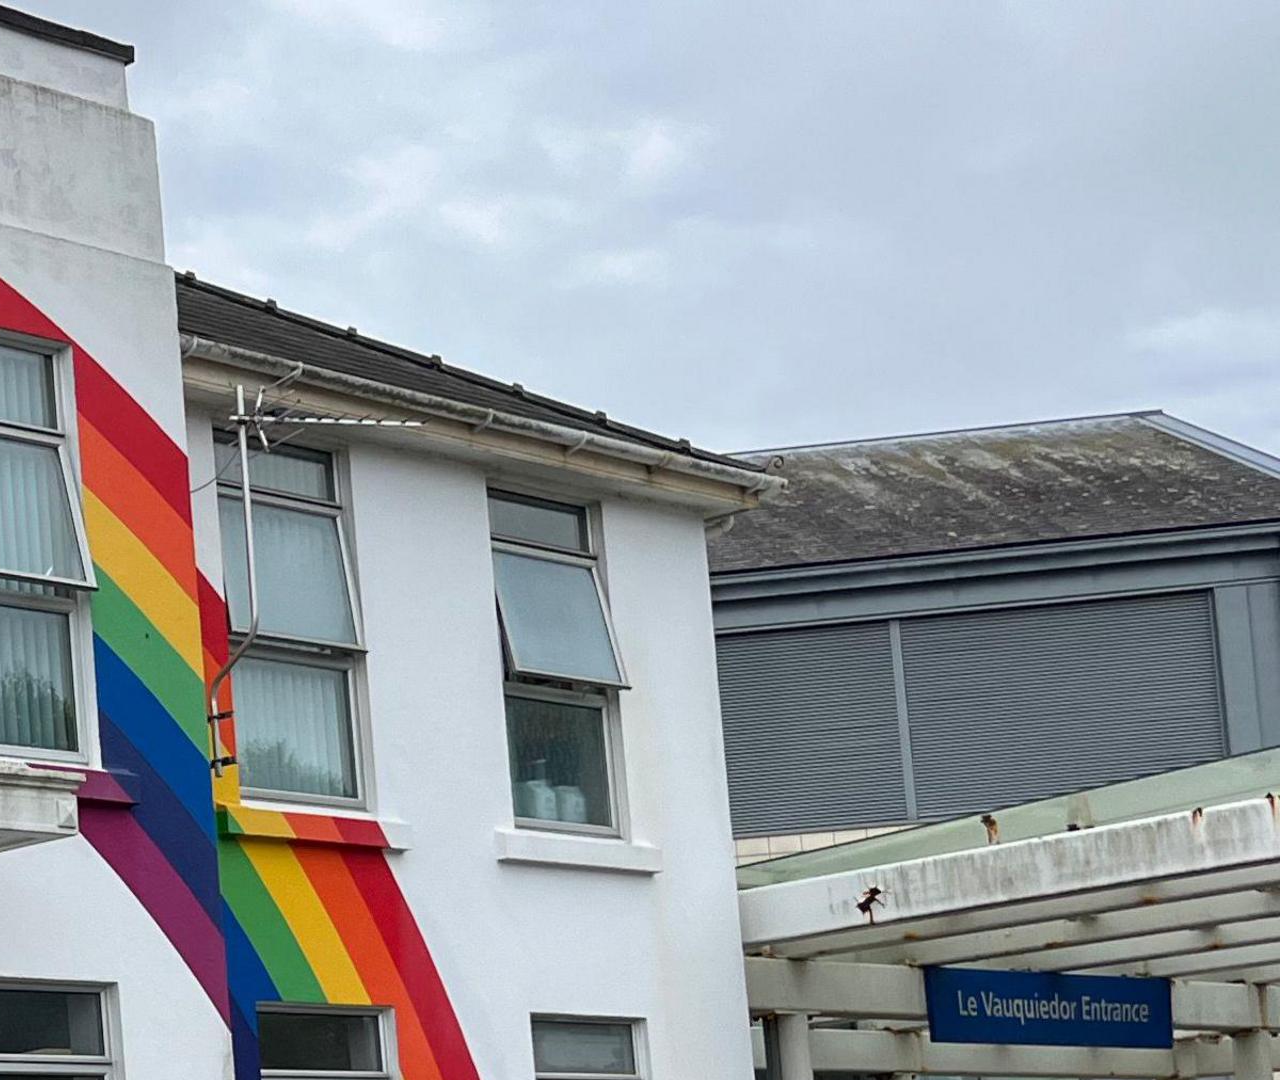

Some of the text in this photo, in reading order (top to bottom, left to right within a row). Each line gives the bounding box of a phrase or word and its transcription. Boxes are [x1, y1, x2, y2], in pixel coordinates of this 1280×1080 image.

[957, 990, 1151, 1026] Le Vauquiedor Entrance
